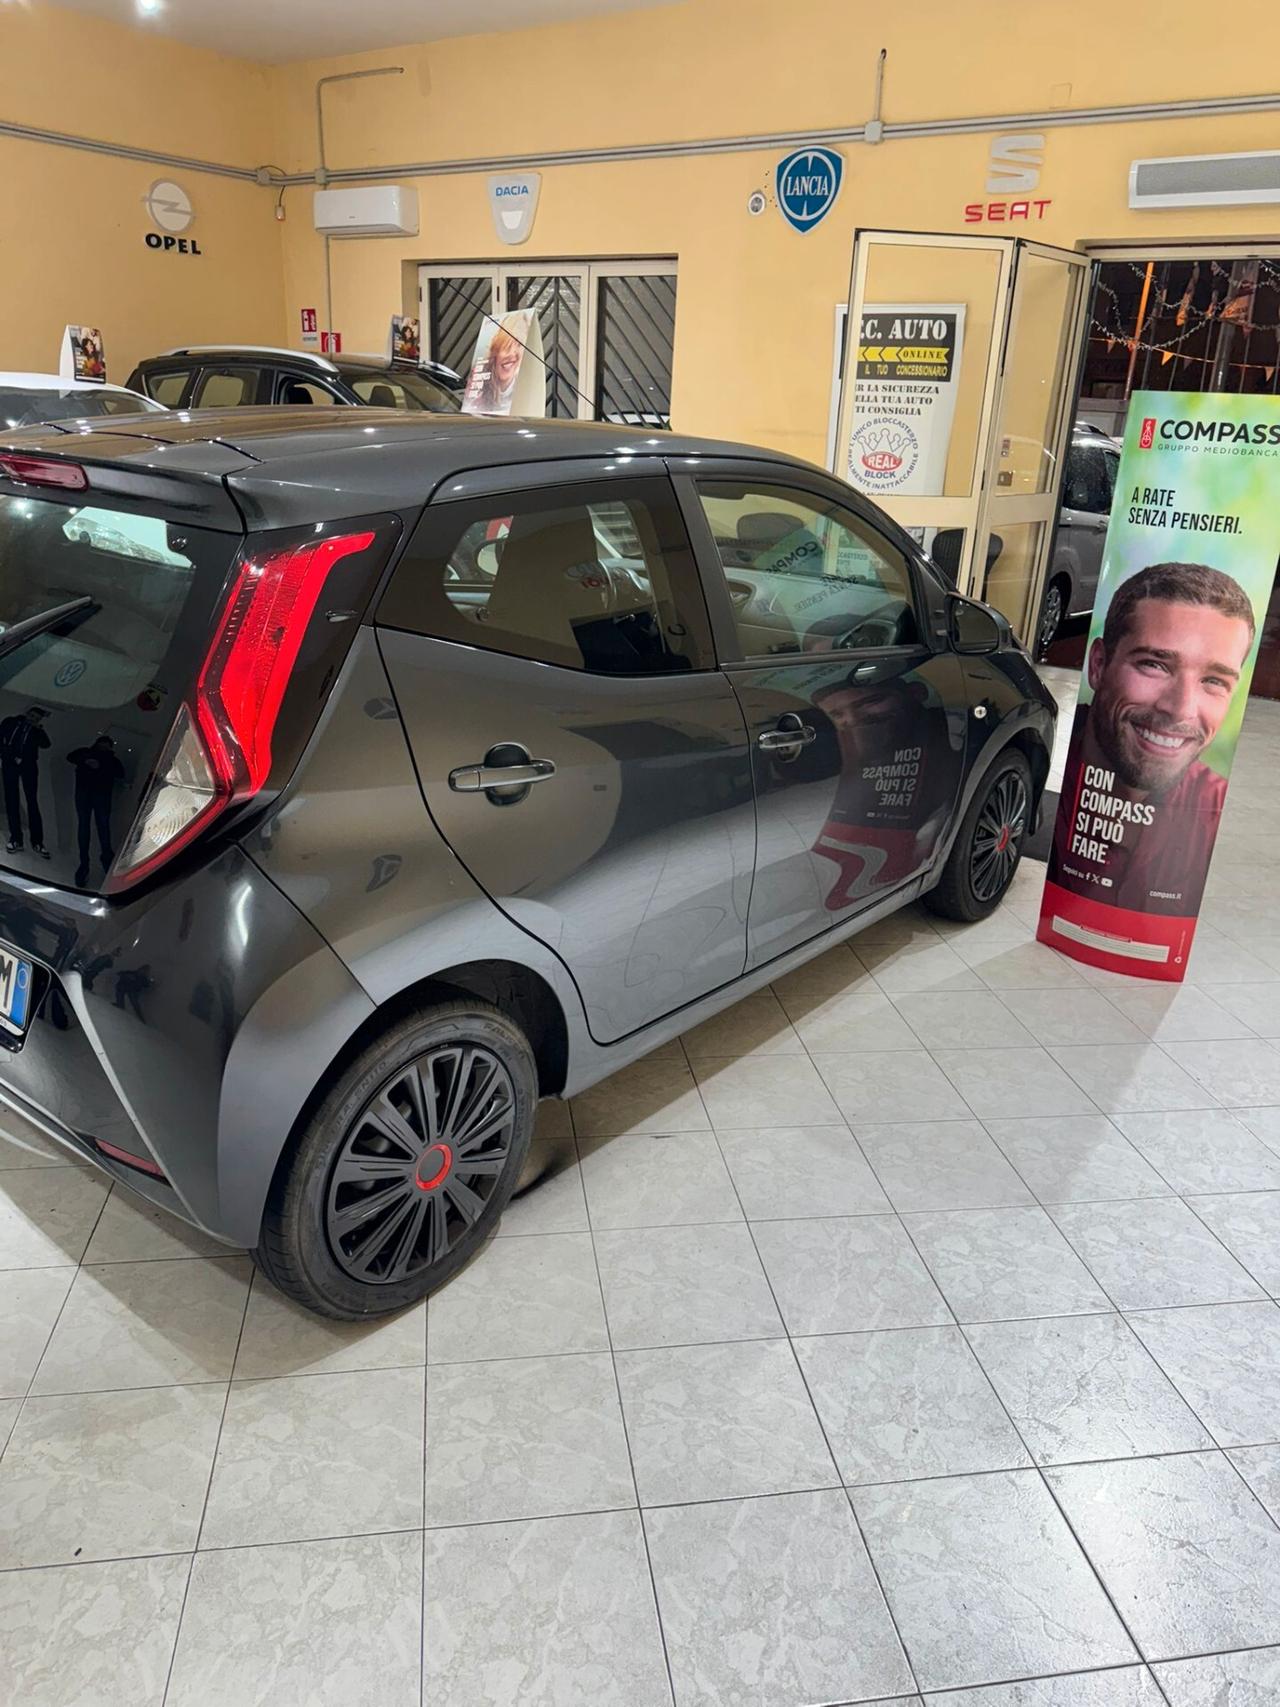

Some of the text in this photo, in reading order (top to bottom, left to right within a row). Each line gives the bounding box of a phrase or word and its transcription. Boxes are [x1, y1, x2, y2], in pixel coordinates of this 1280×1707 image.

[495, 185, 529, 197] DACIA
[785, 175, 830, 196] LANCIA
[965, 200, 1052, 223] SEAT
[145, 233, 202, 255] OPEL
[888, 319, 948, 340] AUTO
[903, 350, 943, 359] ONLINE
[877, 364, 889, 375] TUO
[896, 364, 948, 377] CONCESSIONARIO
[855, 395, 933, 405] ELLA TUA AUTO
[867, 384, 879, 393] LA
[881, 385, 940, 395] SICUREZZA
[867, 406, 922, 416] CONSIGLIA
[873, 417, 919, 450] BLOCCASTERZO
[1160, 419, 1280, 445] COMPASS
[1158, 443, 1278, 457] GRUPPO MEDIOBANCA
[868, 454, 897, 469] REAL
[864, 470, 896, 479] BLOCK
[1131, 486, 1176, 507] A RATE
[1128, 507, 1243, 534] SENZA PENSIERI.
[1085, 765, 1115, 792] CON
[1080, 789, 1156, 826] COMPASS
[1076, 811, 1125, 844] SI PUÒ
[1149, 890, 1182, 900] compass.it
